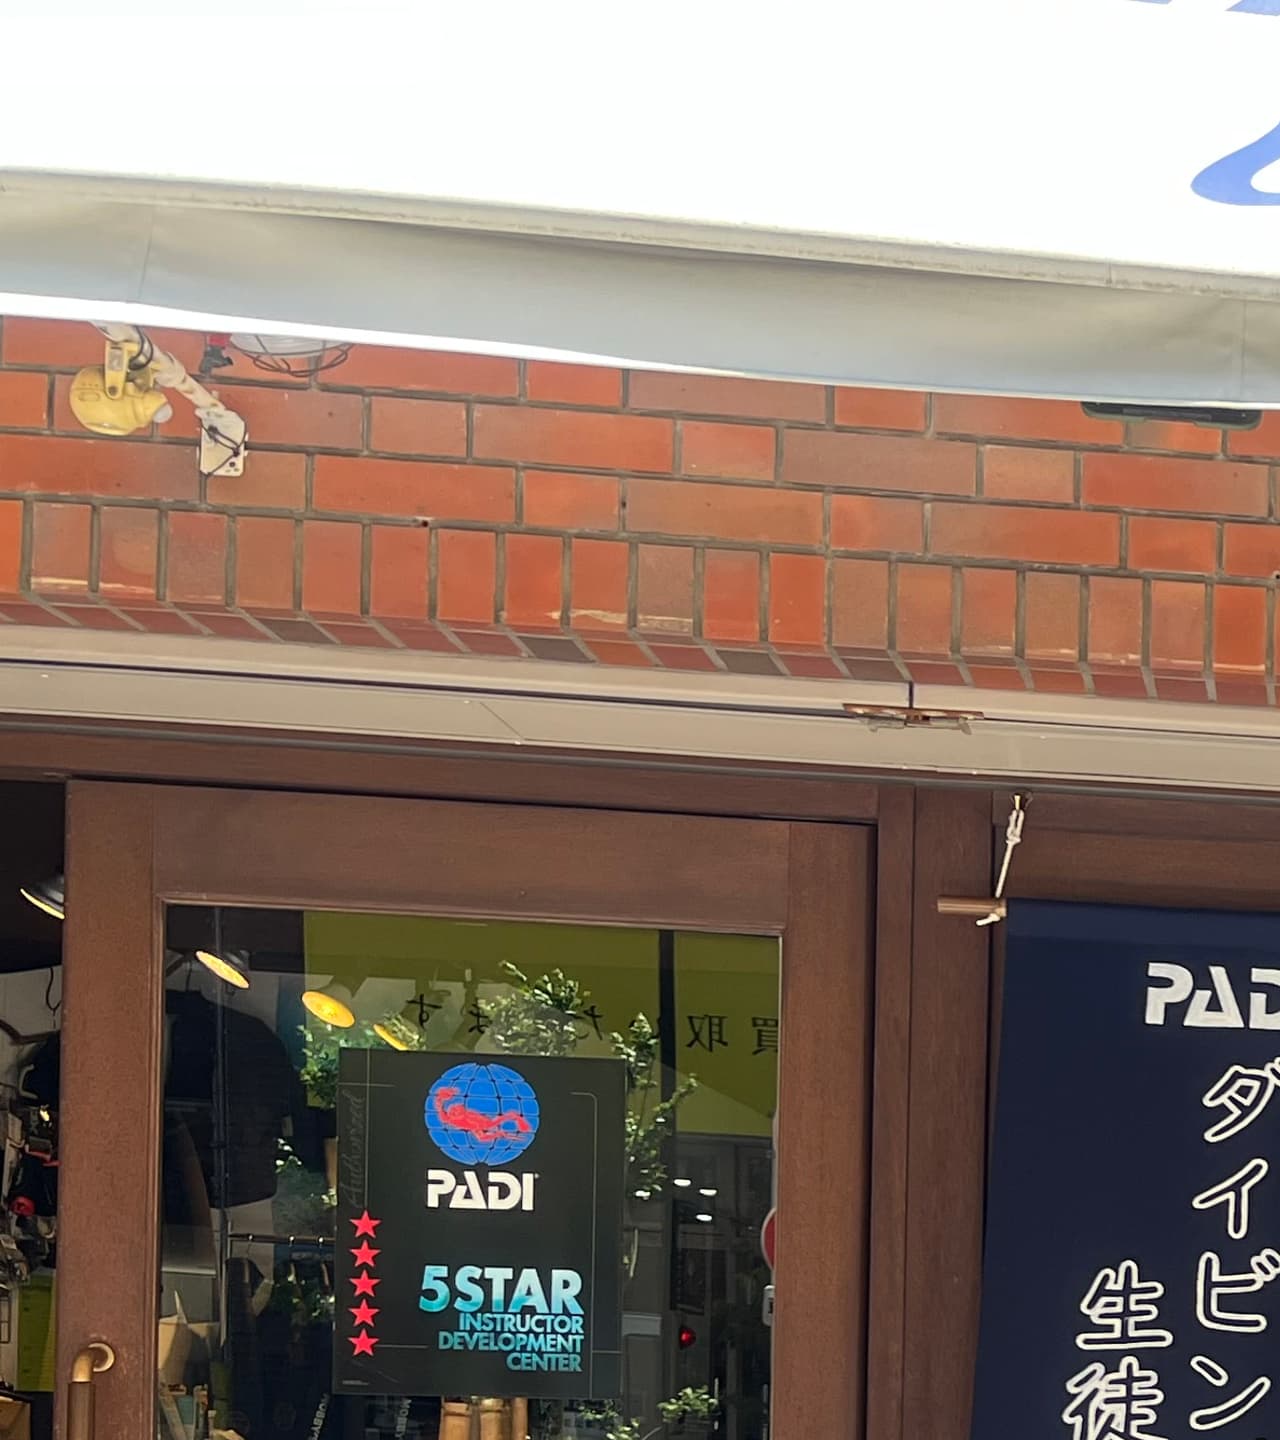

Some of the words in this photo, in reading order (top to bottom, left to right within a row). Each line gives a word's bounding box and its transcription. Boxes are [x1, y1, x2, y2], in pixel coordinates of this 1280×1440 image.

[426, 1169, 536, 1212] PADI
[458, 1312, 584, 1334] INSTRUCTOR
[438, 1331, 584, 1353] DEVELOPMENT
[506, 1352, 582, 1373] CENTER
